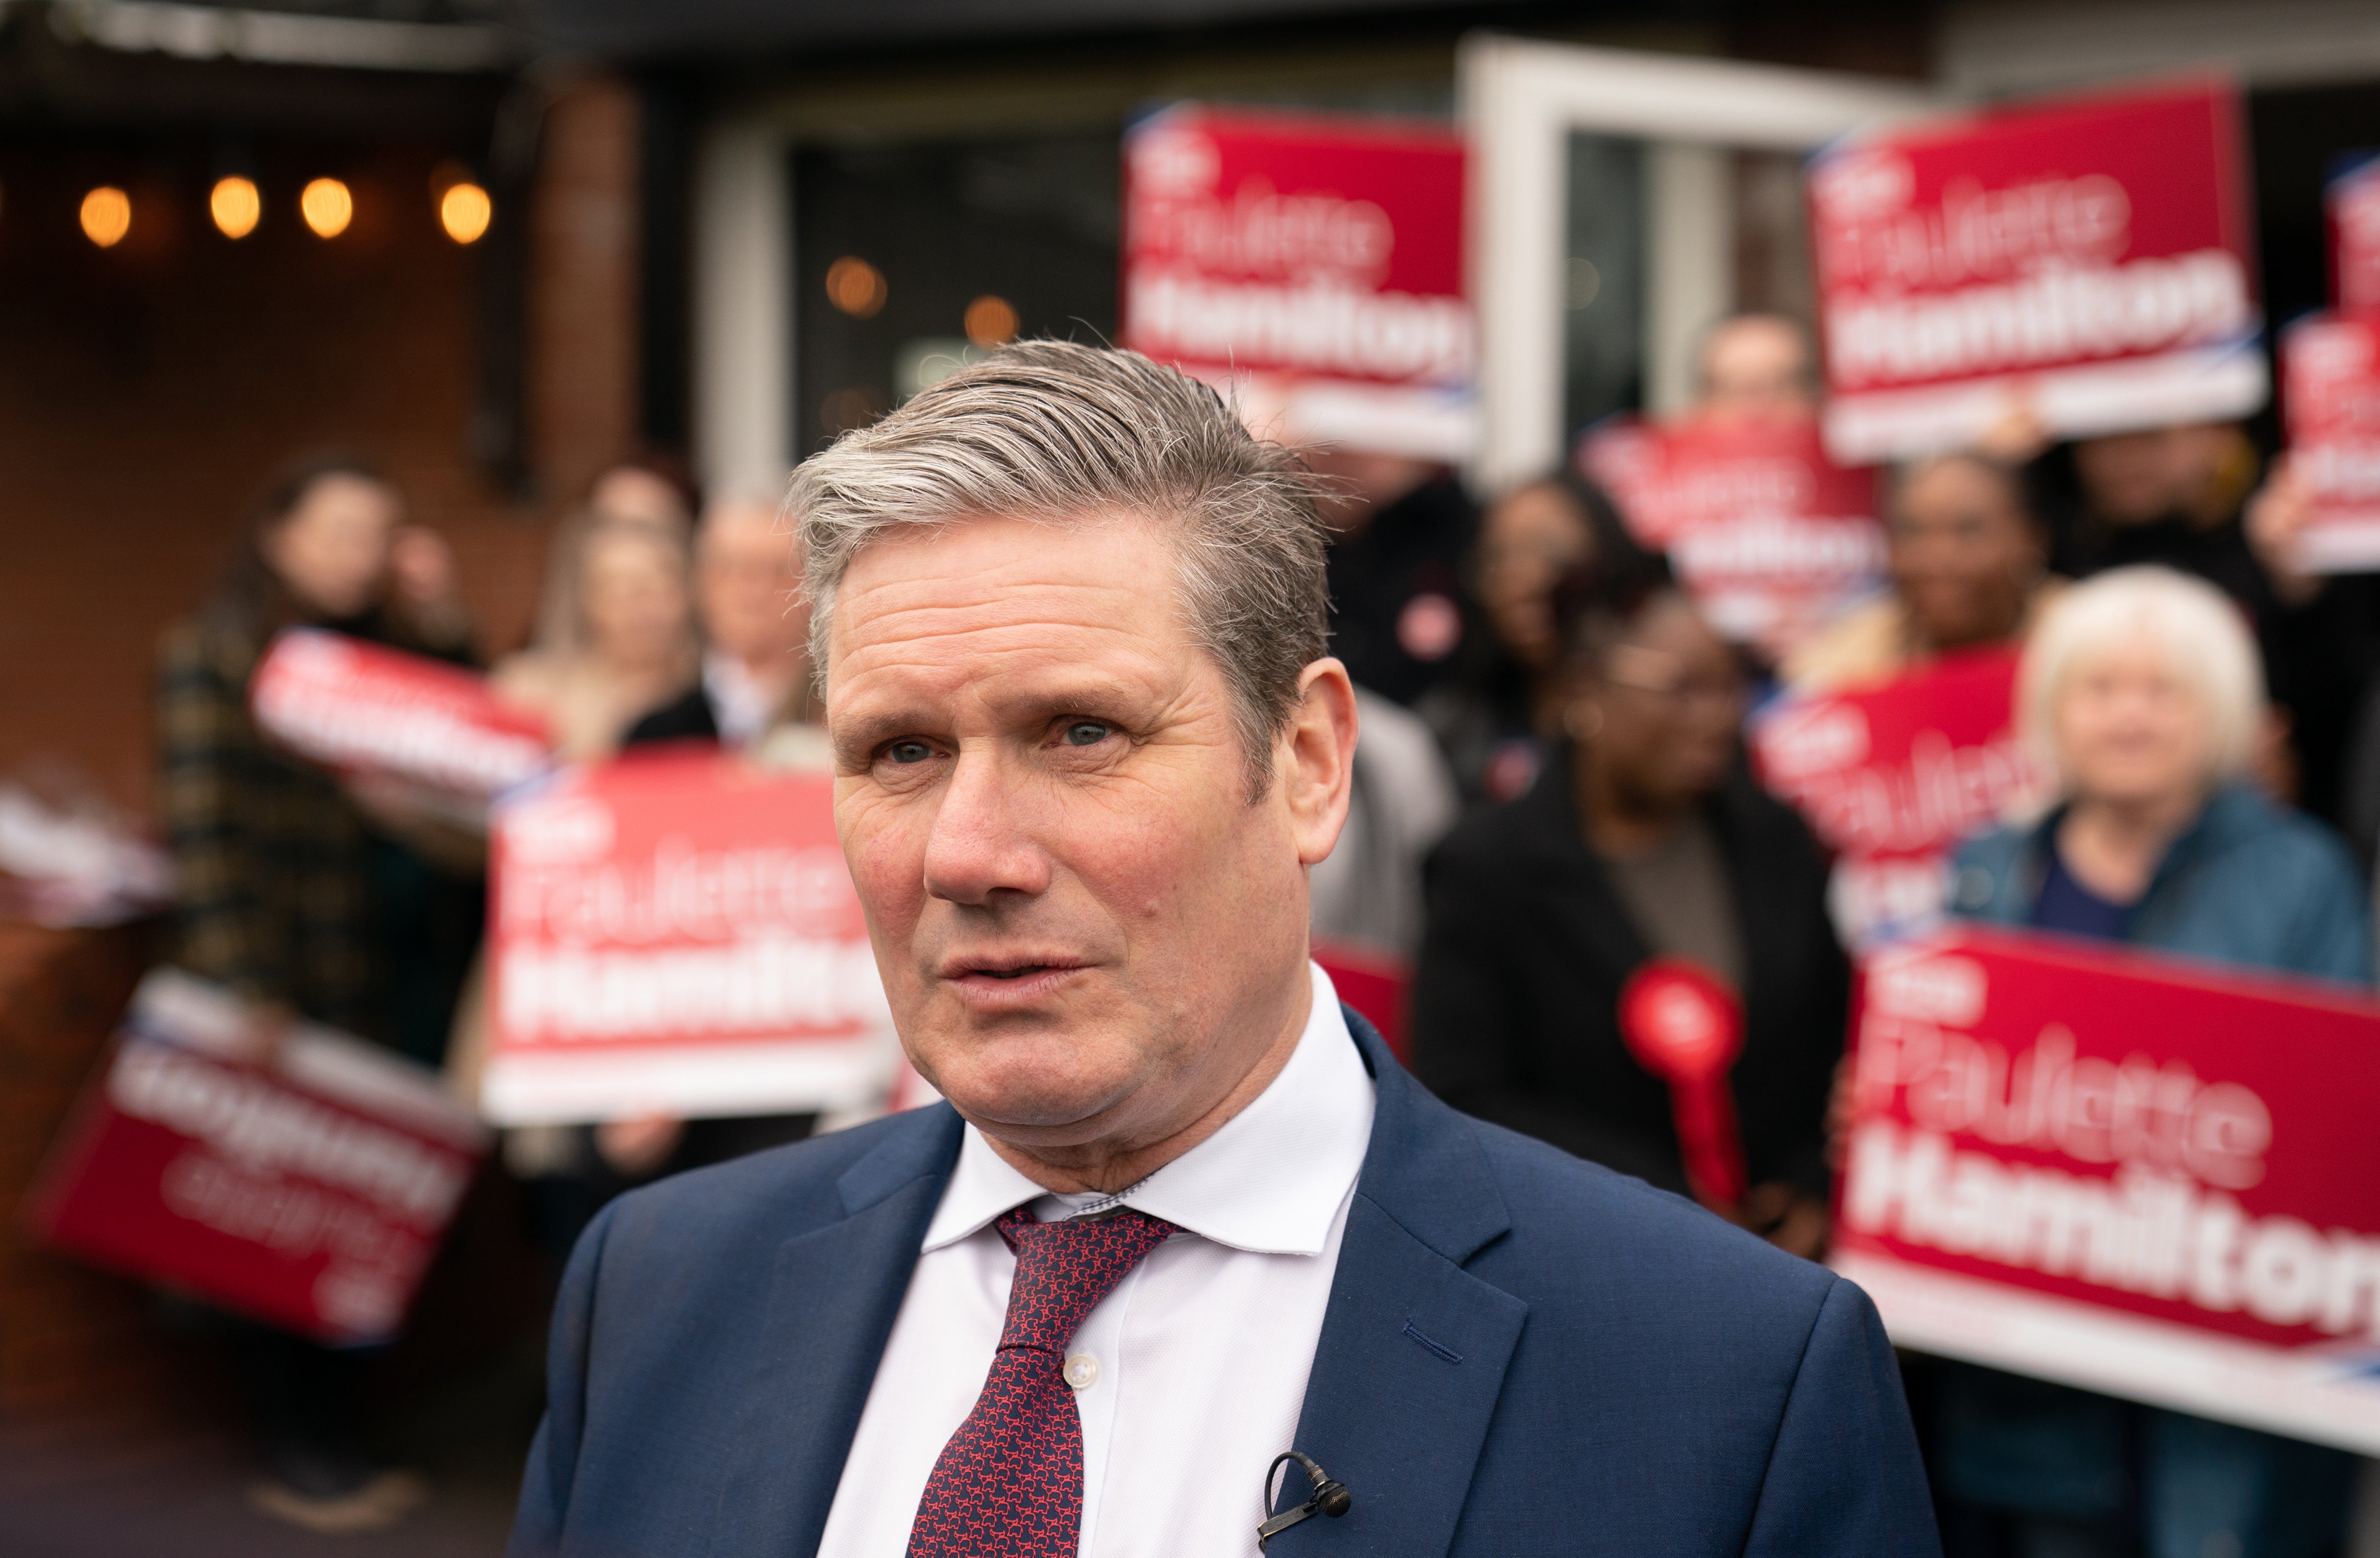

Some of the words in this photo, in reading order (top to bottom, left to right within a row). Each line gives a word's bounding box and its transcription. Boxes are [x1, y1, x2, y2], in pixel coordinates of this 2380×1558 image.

[1827, 251, 2247, 382] Hamilton
[1856, 1021, 2271, 1181] Paulette
[1844, 1120, 2380, 1339] Hamilton
[1266, 1510, 1300, 1531] SONY
